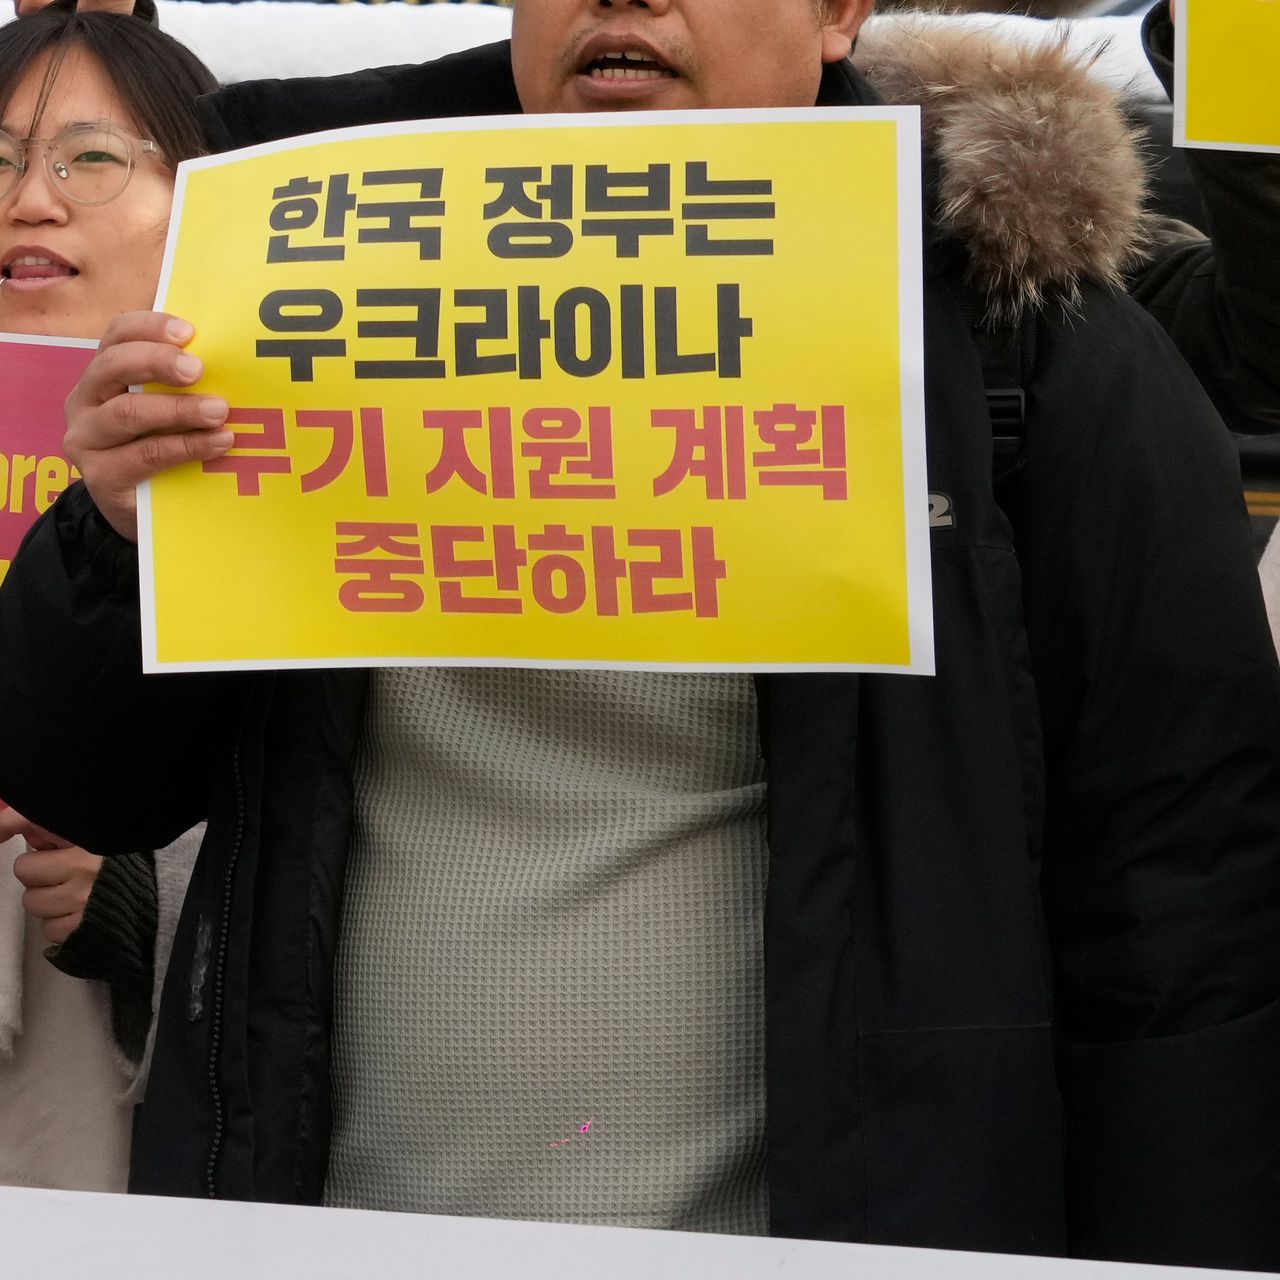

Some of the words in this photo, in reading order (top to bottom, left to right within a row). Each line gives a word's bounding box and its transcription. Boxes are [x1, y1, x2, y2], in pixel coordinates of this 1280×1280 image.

[266, 169, 446, 264] 한국
[484, 162, 775, 258] 정부는
[256, 284, 752, 381] 우크라이나
[206, 408, 387, 496] 무기
[424, 408, 615, 498] 지원
[652, 404, 848, 499] 계획
[336, 523, 726, 617] 중단하라
